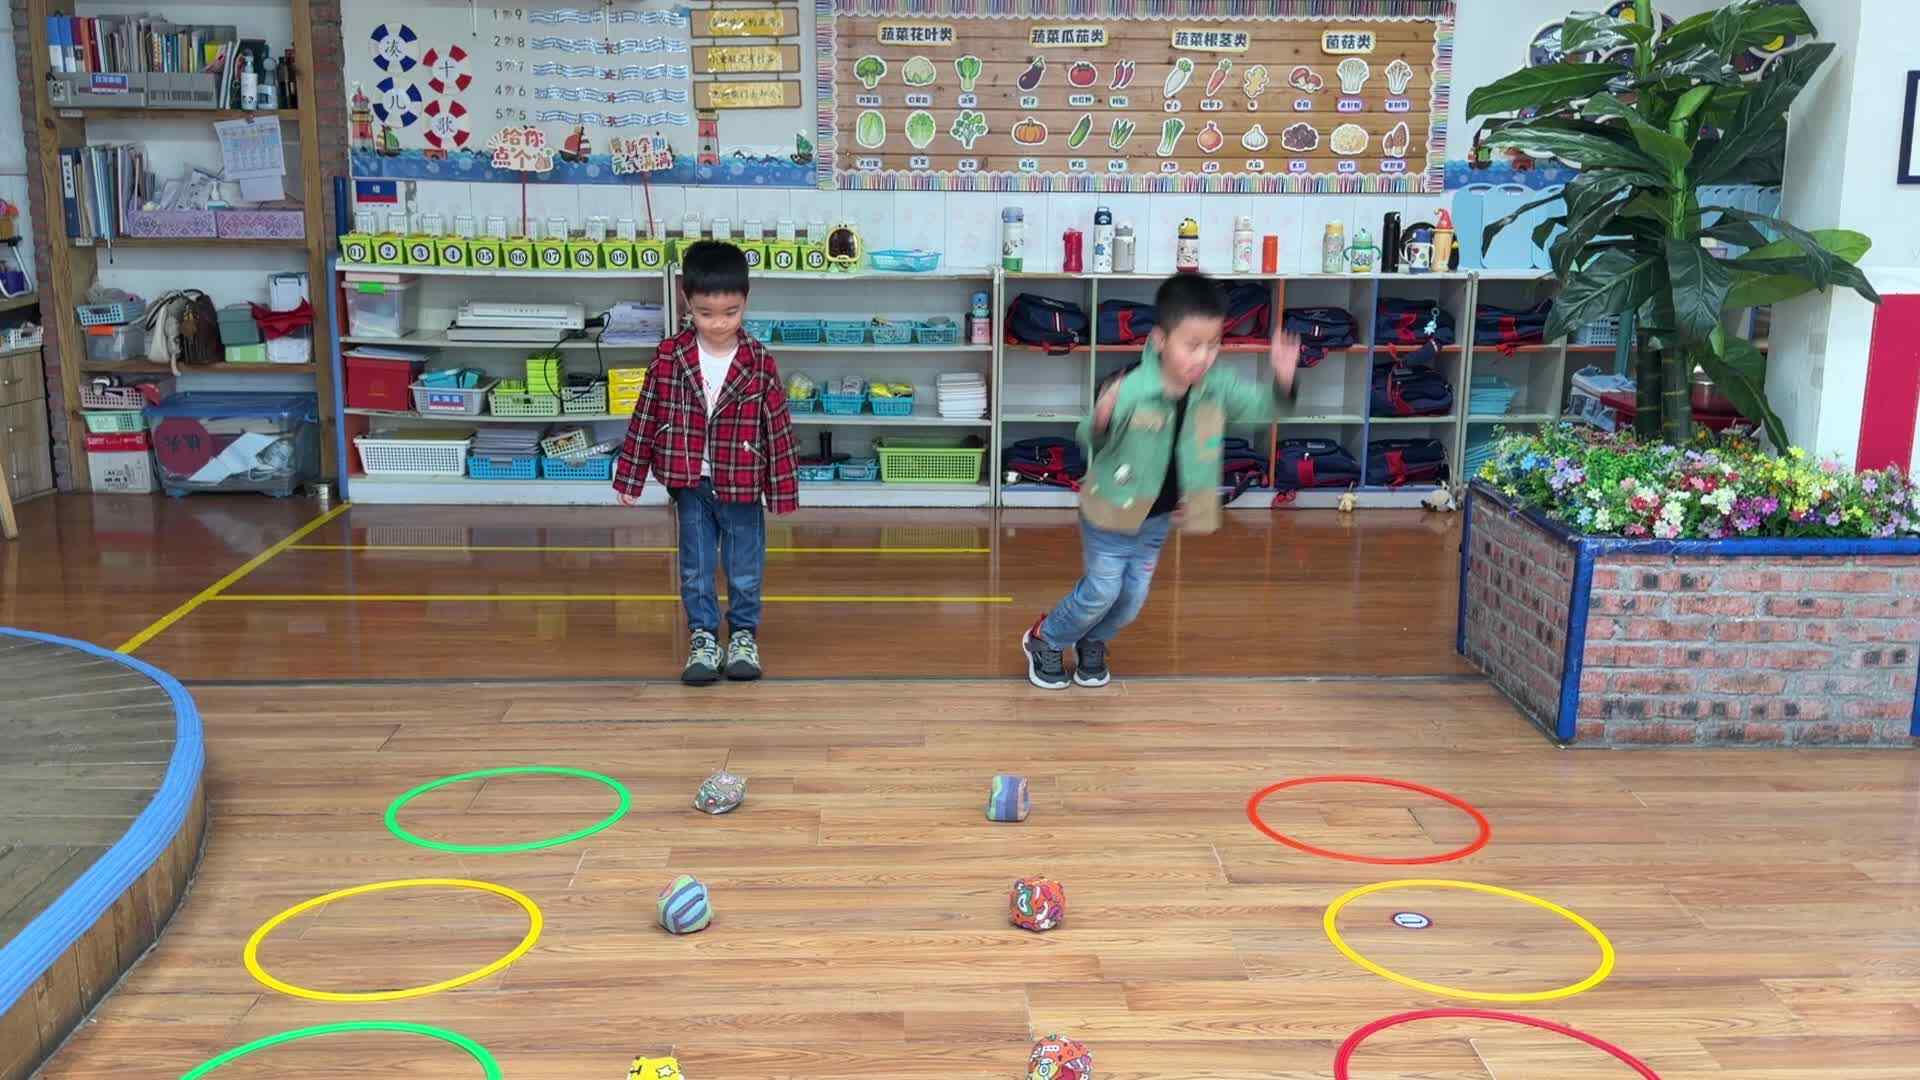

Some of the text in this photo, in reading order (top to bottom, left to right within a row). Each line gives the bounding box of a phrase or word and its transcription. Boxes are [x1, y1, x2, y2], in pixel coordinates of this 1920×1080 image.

[881, 26, 953, 42] 蔬菜花叶类
[1032, 28, 1104, 44] 蔬菜瓜茄类
[1175, 31, 1247, 48] 蔬菜根茎类
[1326, 34, 1371, 50] 菌菇类
[439, 61, 455, 78] 十
[390, 95, 406, 110] 儿
[502, 128, 544, 147] 给你
[479, 251, 491, 262] 05
[546, 251, 558, 261] 07
[579, 252, 592, 263] 08
[612, 251, 625, 262] 09
[644, 252, 657, 262] 10
[778, 254, 791, 266] 14
[810, 254, 823, 265] 15
